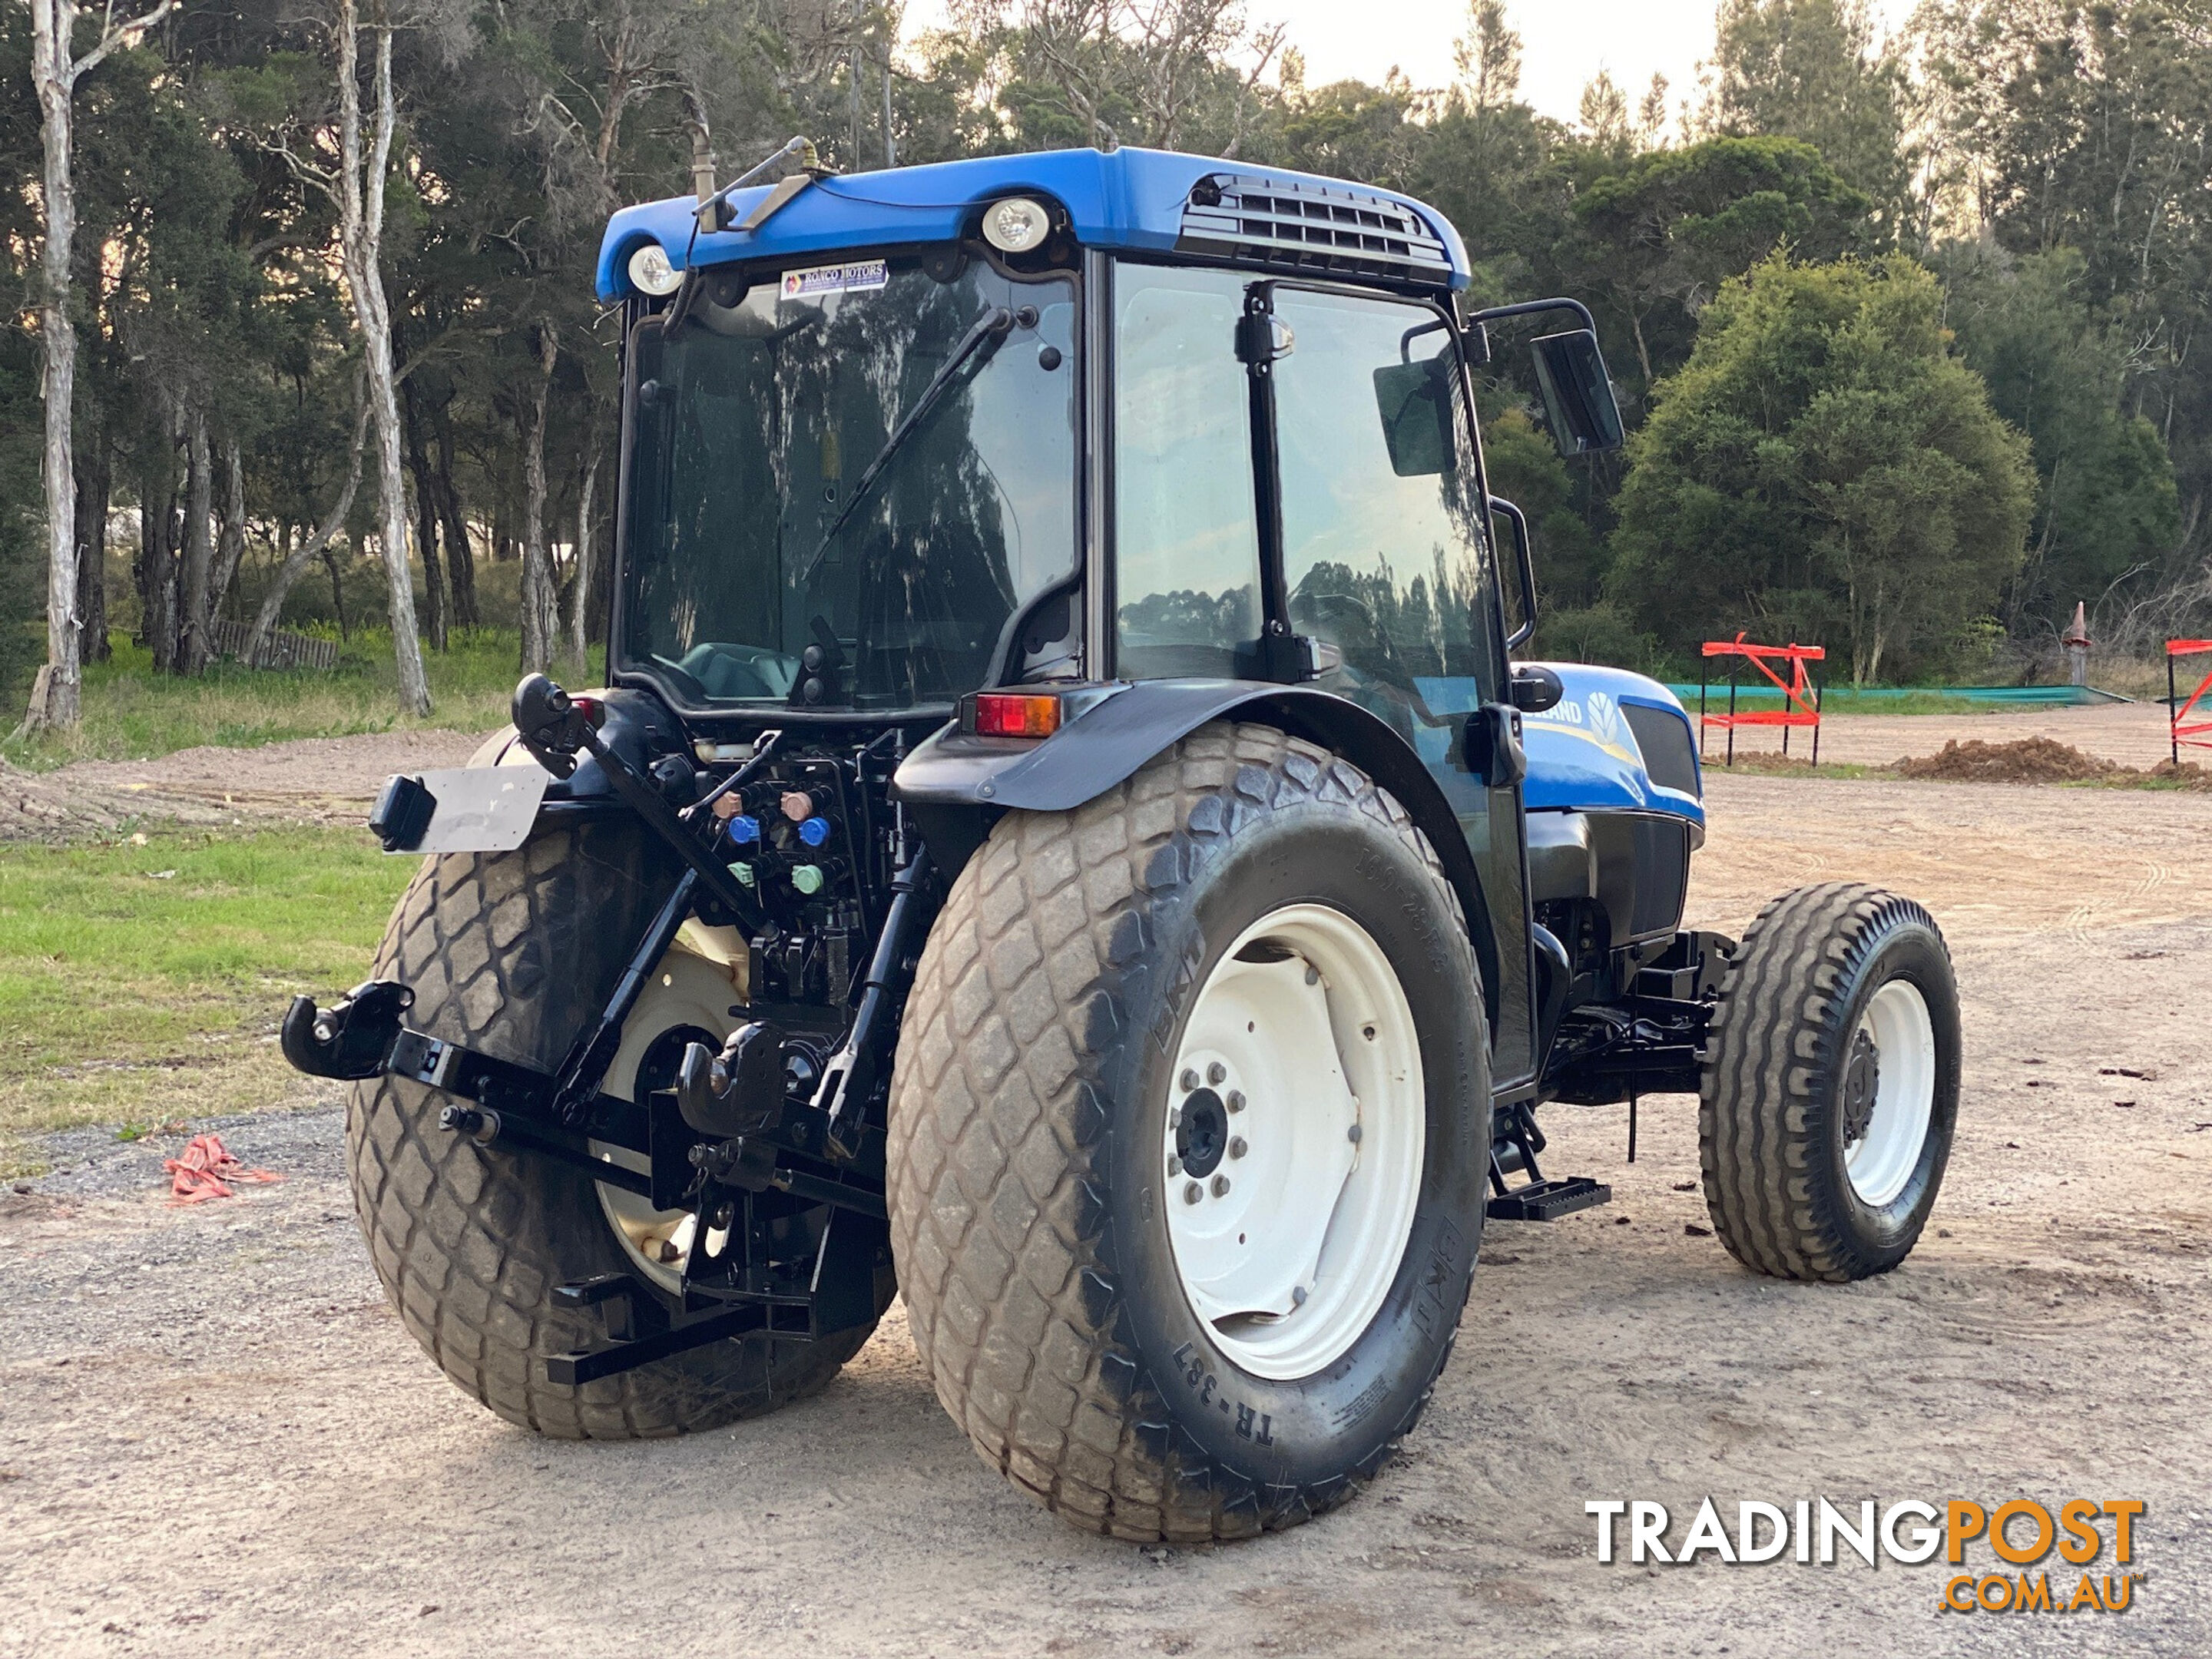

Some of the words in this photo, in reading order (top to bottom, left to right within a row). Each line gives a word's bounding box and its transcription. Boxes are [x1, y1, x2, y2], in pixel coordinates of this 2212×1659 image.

[804, 270, 839, 283] RONCO
[841, 264, 883, 279] MOTORS
[1152, 925, 1204, 1051] BKT
